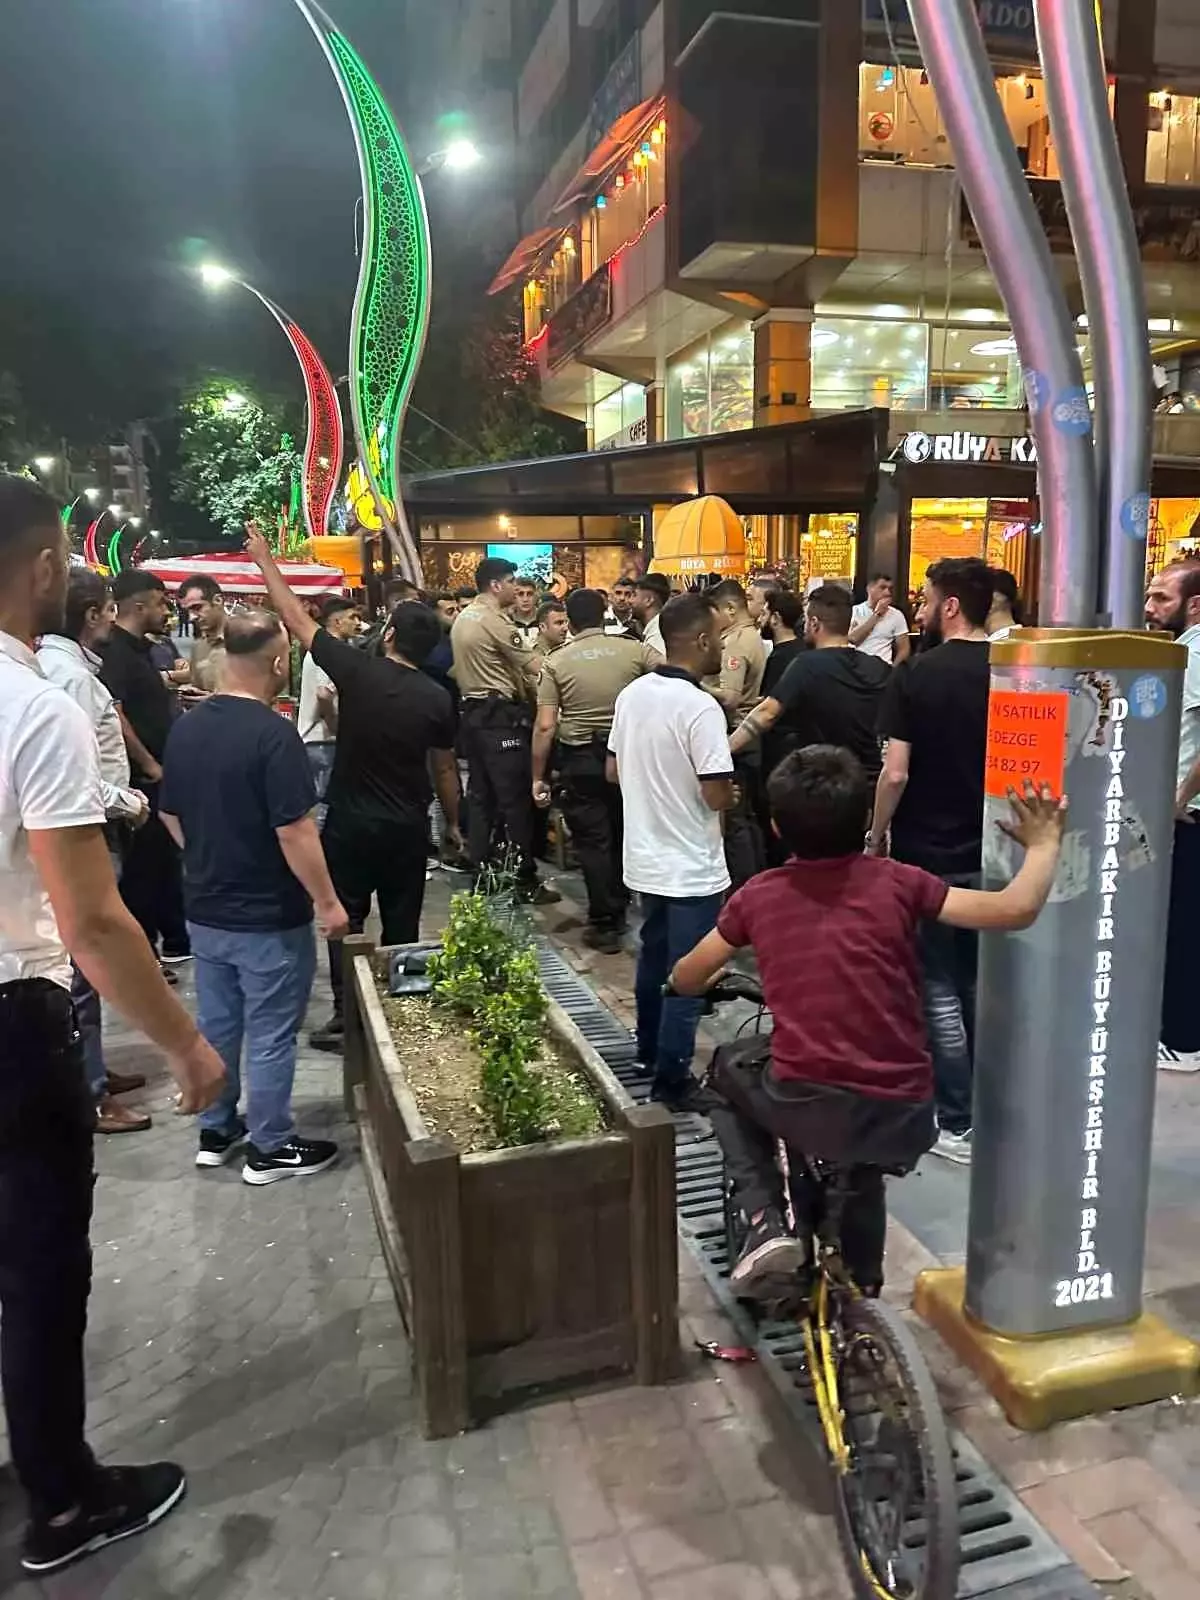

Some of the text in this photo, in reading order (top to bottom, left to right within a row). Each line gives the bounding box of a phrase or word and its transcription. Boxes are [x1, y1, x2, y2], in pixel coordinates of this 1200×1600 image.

[934, 431, 1001, 460] RÜYA
[1002, 704, 1057, 720] SATILIK
[994, 730, 1038, 747] DEZGE
[1000, 758, 1017, 772] 82
[1021, 760, 1041, 775] 97
[1097, 697, 1129, 941] DİYARBAKIR
[1055, 1272, 1115, 1307] 2021
